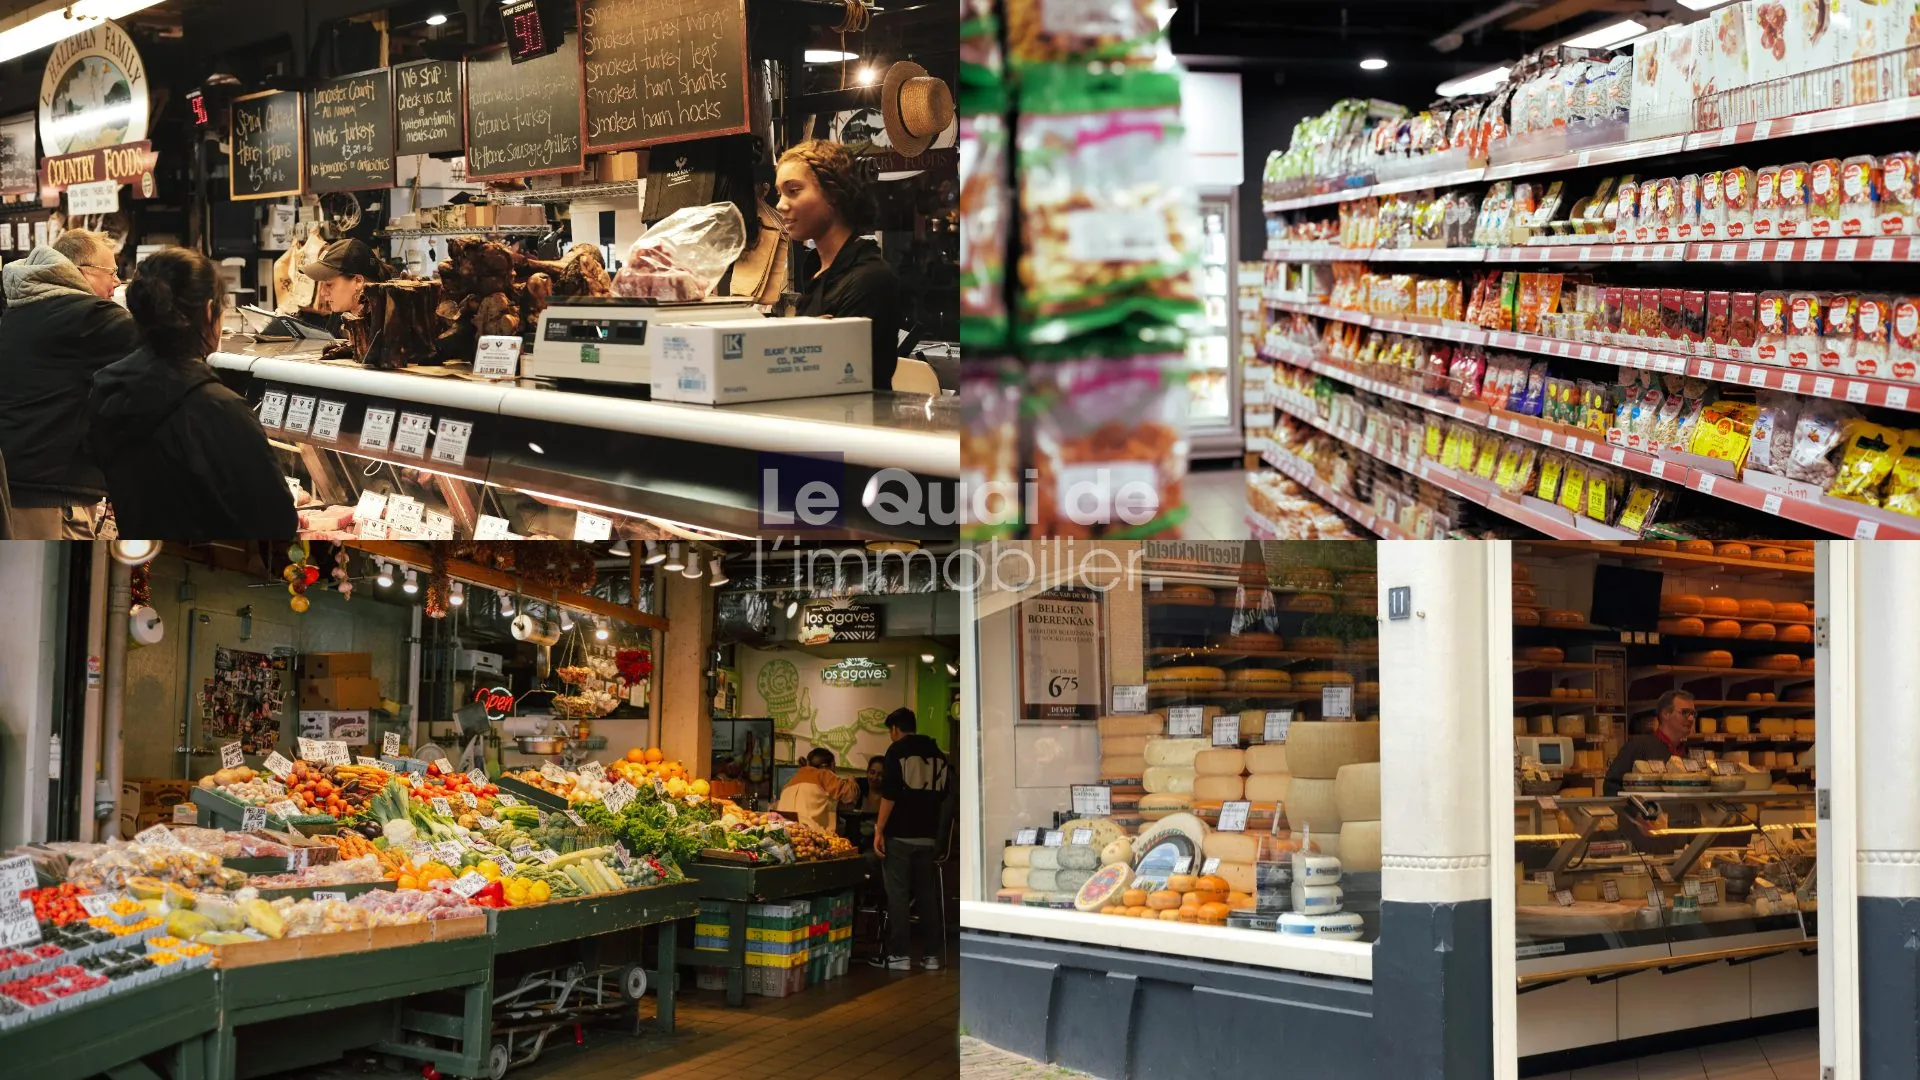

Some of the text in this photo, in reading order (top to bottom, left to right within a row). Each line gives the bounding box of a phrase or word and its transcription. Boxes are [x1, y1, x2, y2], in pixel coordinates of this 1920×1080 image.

[514, 1, 534, 13] SERVING
[585, 26, 636, 55] Smoked
[642, 19, 681, 44] turkey
[104, 26, 142, 85] FAMILY
[586, 41, 717, 83] Smoked turkey legs
[402, 68, 418, 88] We
[587, 79, 638, 104] Smoked
[644, 75, 674, 99] ham
[679, 72, 727, 95] shanks
[314, 85, 347, 109] Lancaster
[475, 105, 553, 138] Ground turkey
[589, 99, 722, 138] Smoked ham hocks
[313, 121, 376, 148] Whole turkeys
[48, 154, 96, 186] COUNTRY
[103, 147, 144, 181] FOODS
[790, 345, 822, 355] PLASTICS
[1038, 603, 1084, 615] BELEGEN
[1391, 591, 1404, 614] 11
[806, 612, 876, 626] los agaves
[1028, 614, 1094, 627] BOERENKAAS
[822, 668, 887, 682] los agaves
[475, 688, 514, 712] Open
